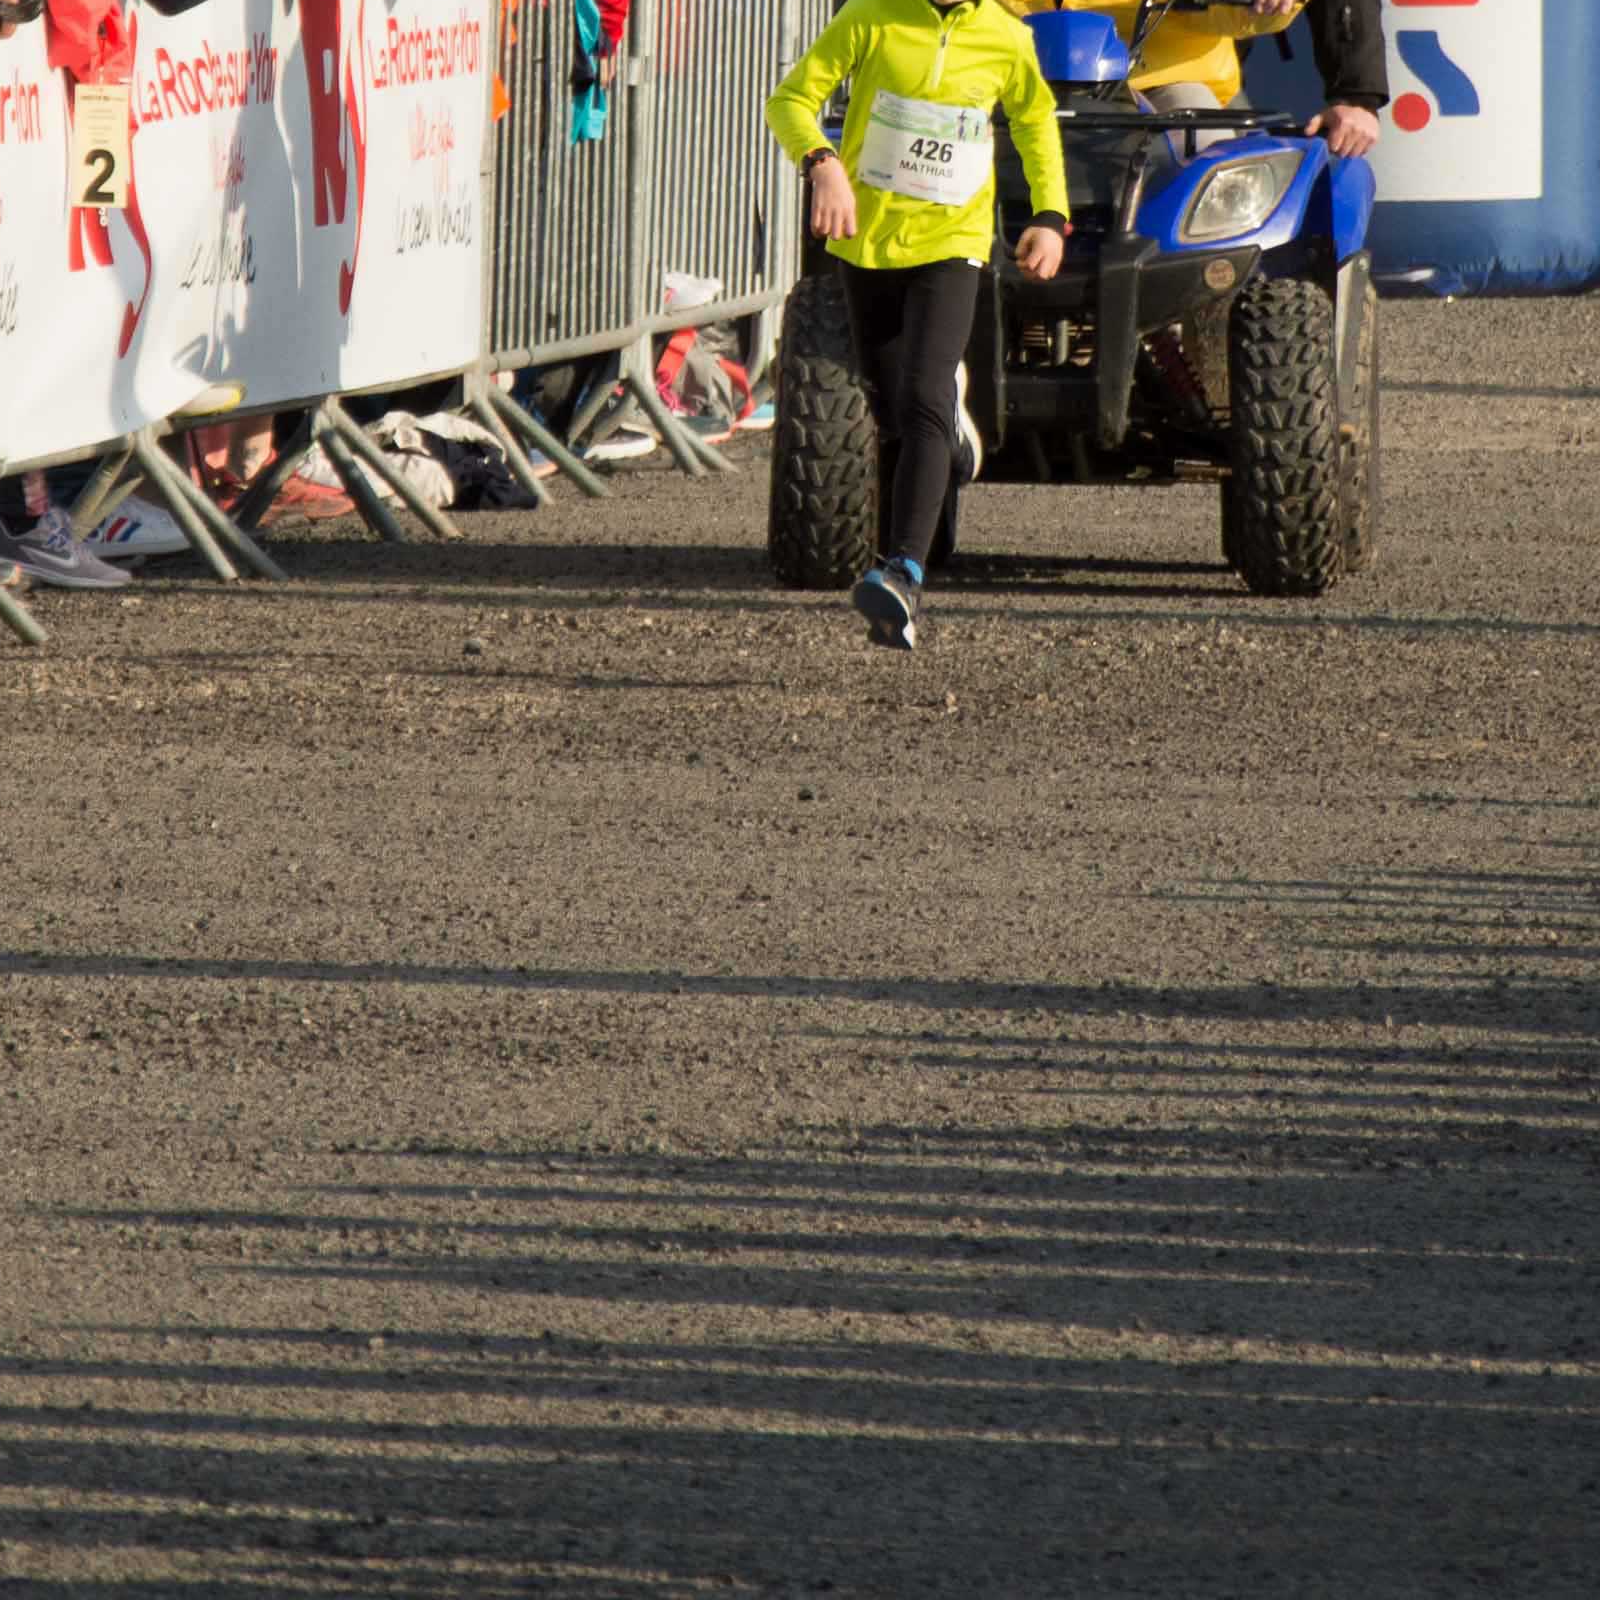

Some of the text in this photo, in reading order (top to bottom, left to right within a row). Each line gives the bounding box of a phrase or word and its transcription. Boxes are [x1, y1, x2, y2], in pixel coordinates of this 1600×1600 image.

[909, 138, 954, 164] 426
[83, 148, 116, 203] 2
[899, 159, 953, 179] MATHIAS
